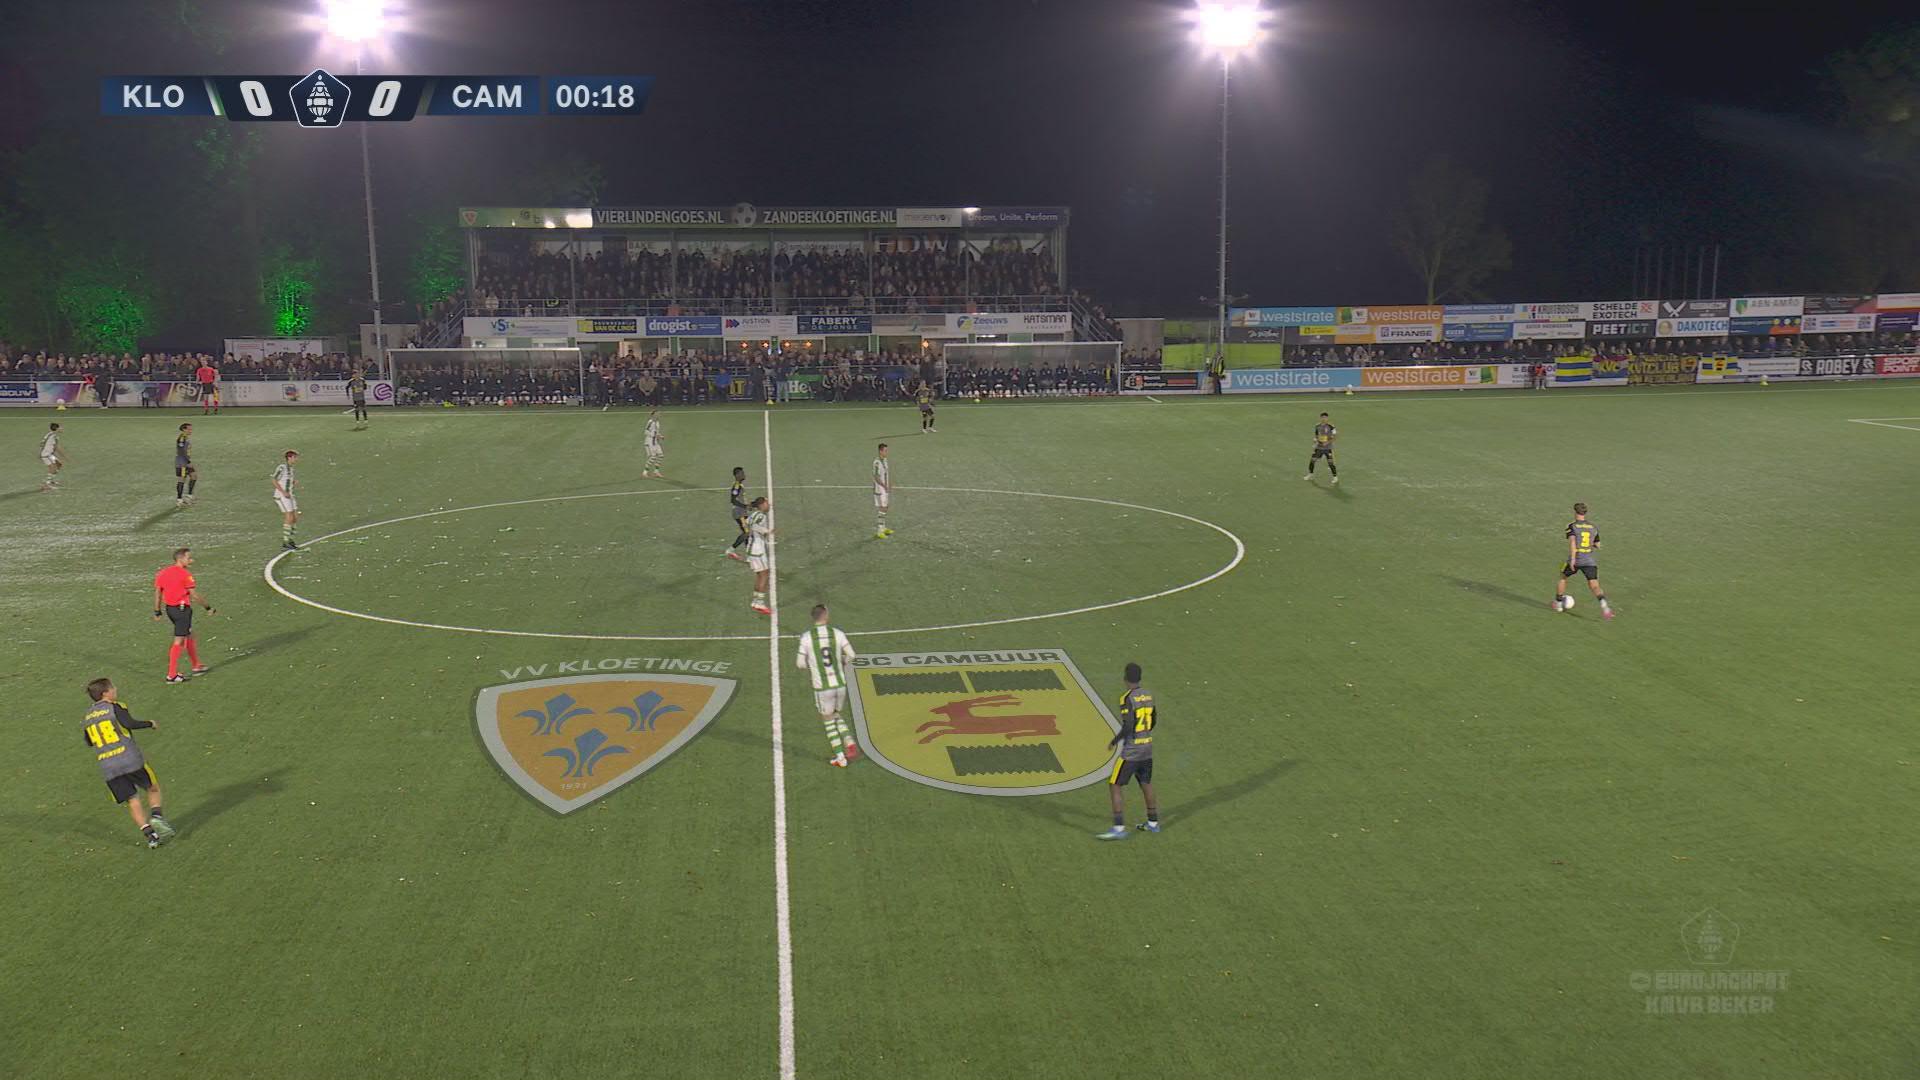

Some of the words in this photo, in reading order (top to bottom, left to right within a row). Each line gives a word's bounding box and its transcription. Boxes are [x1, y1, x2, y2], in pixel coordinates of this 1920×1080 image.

[597, 211, 725, 224] VIERLINDENGOES.NL
[764, 210, 896, 223] ZANDEEKLOETINGE.NL
[1025, 212, 1058, 222] Perform
[1593, 302, 1638, 311] SCHELDE
[811, 316, 857, 325] FABERY
[1262, 309, 1335, 323] weststrate
[1368, 308, 1441, 322] weststrate
[1593, 311, 1638, 320] EXOTECH
[1677, 320, 1729, 332] DAKOTECH
[1816, 358, 1860, 375] ROBEY
[1237, 371, 1330, 387] weststrate
[1367, 369, 1460, 384] weststrate
[1580, 531, 1591, 547] 3
[821, 646, 832, 667] 9
[1135, 706, 1153, 733] 21
[86, 719, 120, 748] 48
